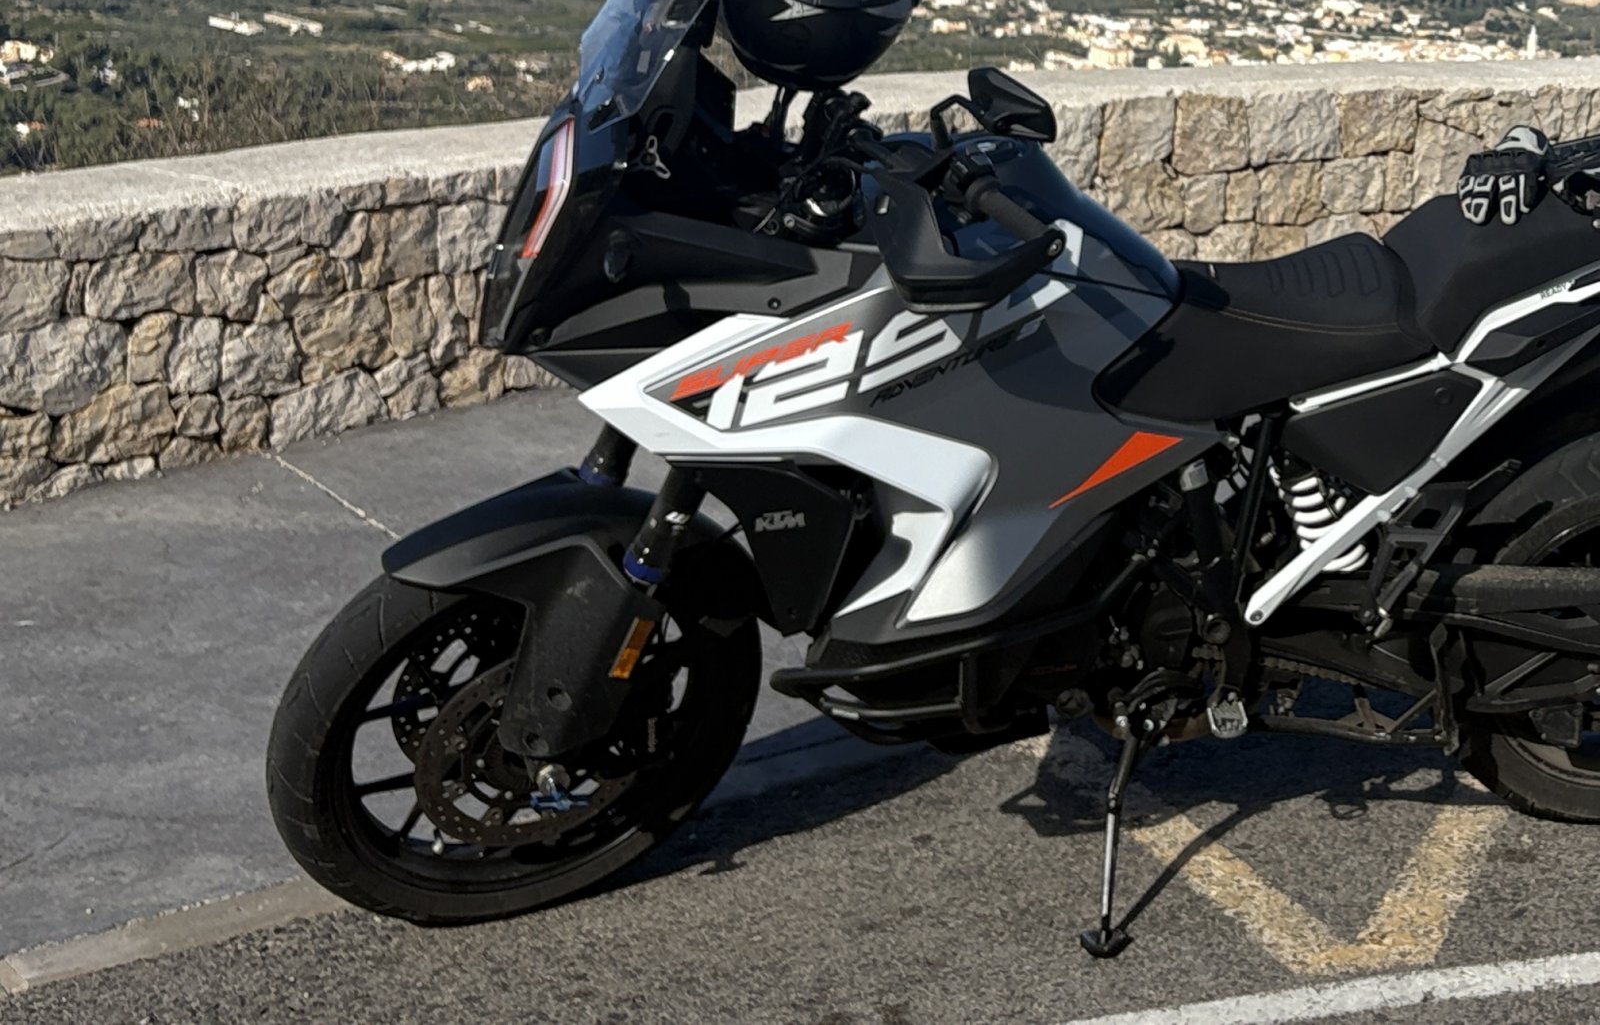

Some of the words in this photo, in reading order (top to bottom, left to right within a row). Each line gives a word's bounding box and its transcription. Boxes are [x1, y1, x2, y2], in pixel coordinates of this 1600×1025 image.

[669, 321, 856, 402] SUPER
[870, 329, 1017, 408] ADVENTURE
[754, 509, 807, 533] KTM
